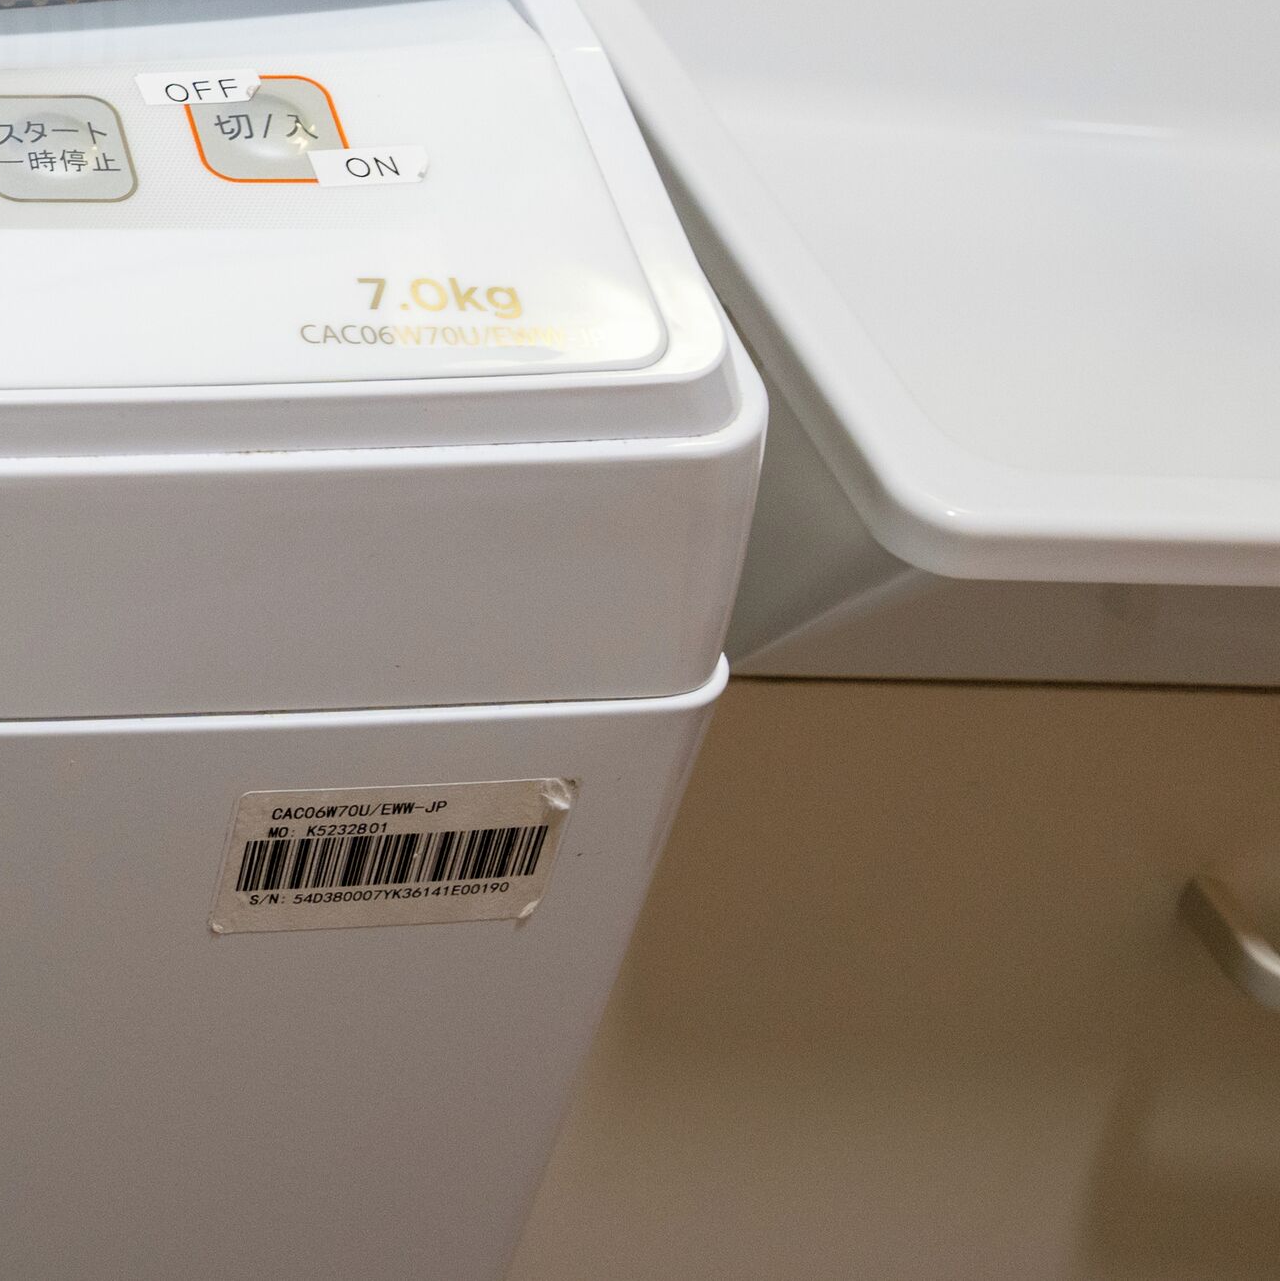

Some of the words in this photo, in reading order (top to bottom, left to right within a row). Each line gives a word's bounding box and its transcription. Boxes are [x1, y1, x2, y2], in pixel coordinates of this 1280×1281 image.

[165, 78, 238, 103] OFF
[345, 156, 401, 179] ON
[357, 277, 523, 320] 7.0kg
[272, 800, 448, 821] CAC06W70U/EWW-JP
[306, 823, 388, 837] K5232801
[249, 892, 286, 906] S/N:
